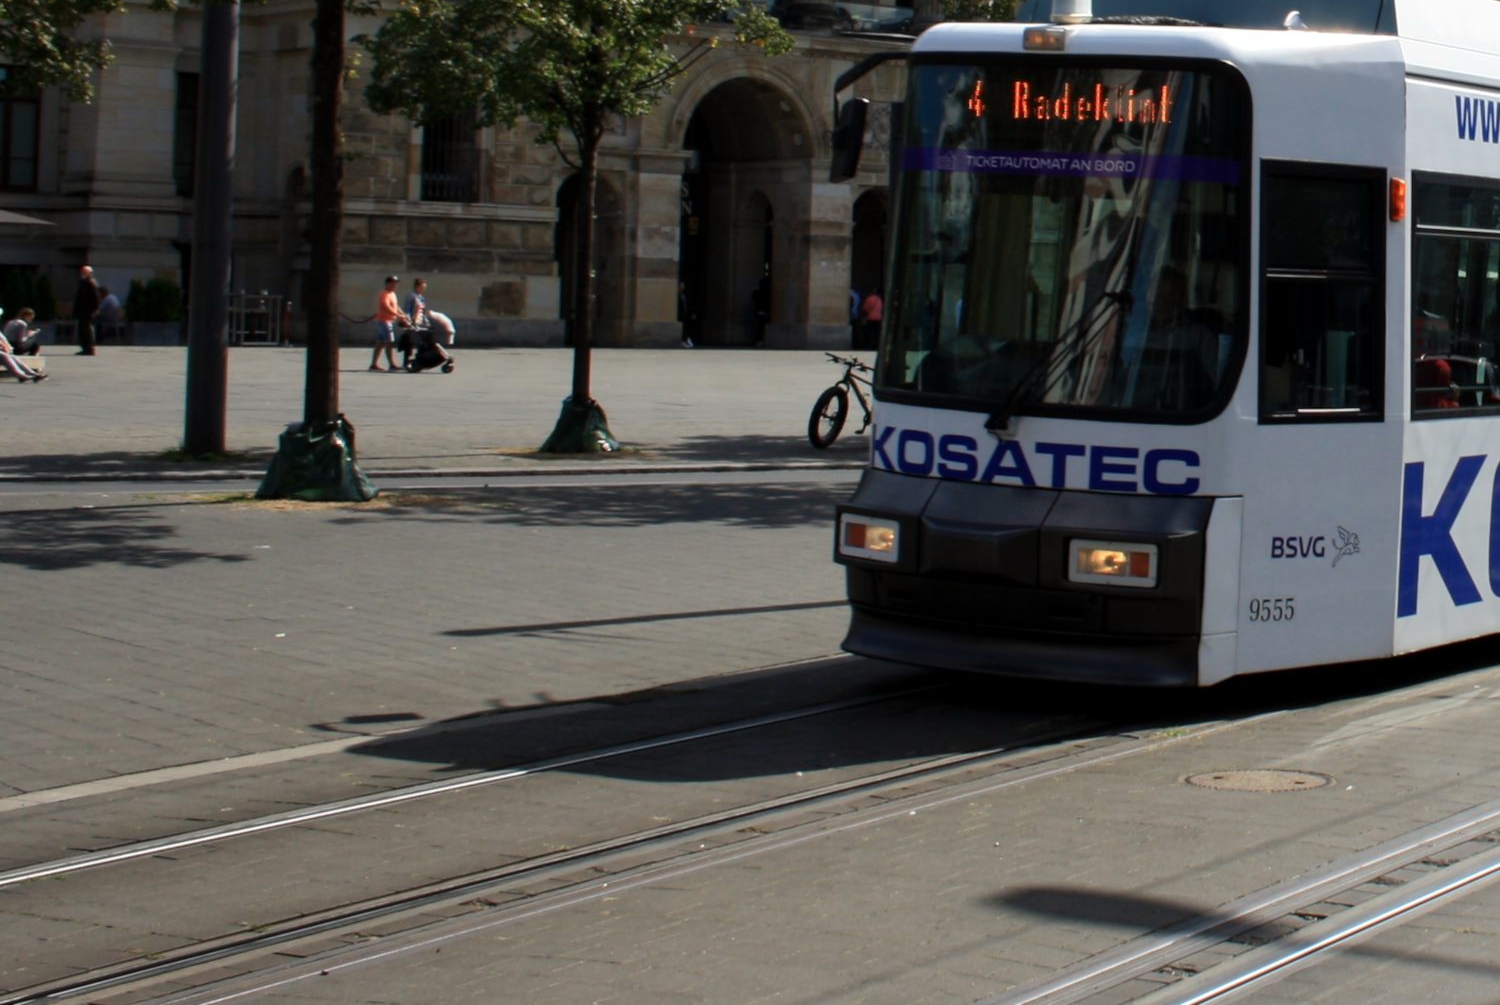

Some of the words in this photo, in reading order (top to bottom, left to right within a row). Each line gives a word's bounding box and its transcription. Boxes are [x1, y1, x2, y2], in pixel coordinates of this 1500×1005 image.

[968, 80, 985, 117] 4
[966, 155, 1068, 170] TICKETAUTOMAT
[1070, 158, 1091, 171] AN
[1096, 159, 1136, 173] BORD
[872, 424, 1200, 496] KOSATEC
[1271, 536, 1325, 558] BSVG
[1249, 598, 1295, 622] 9555
